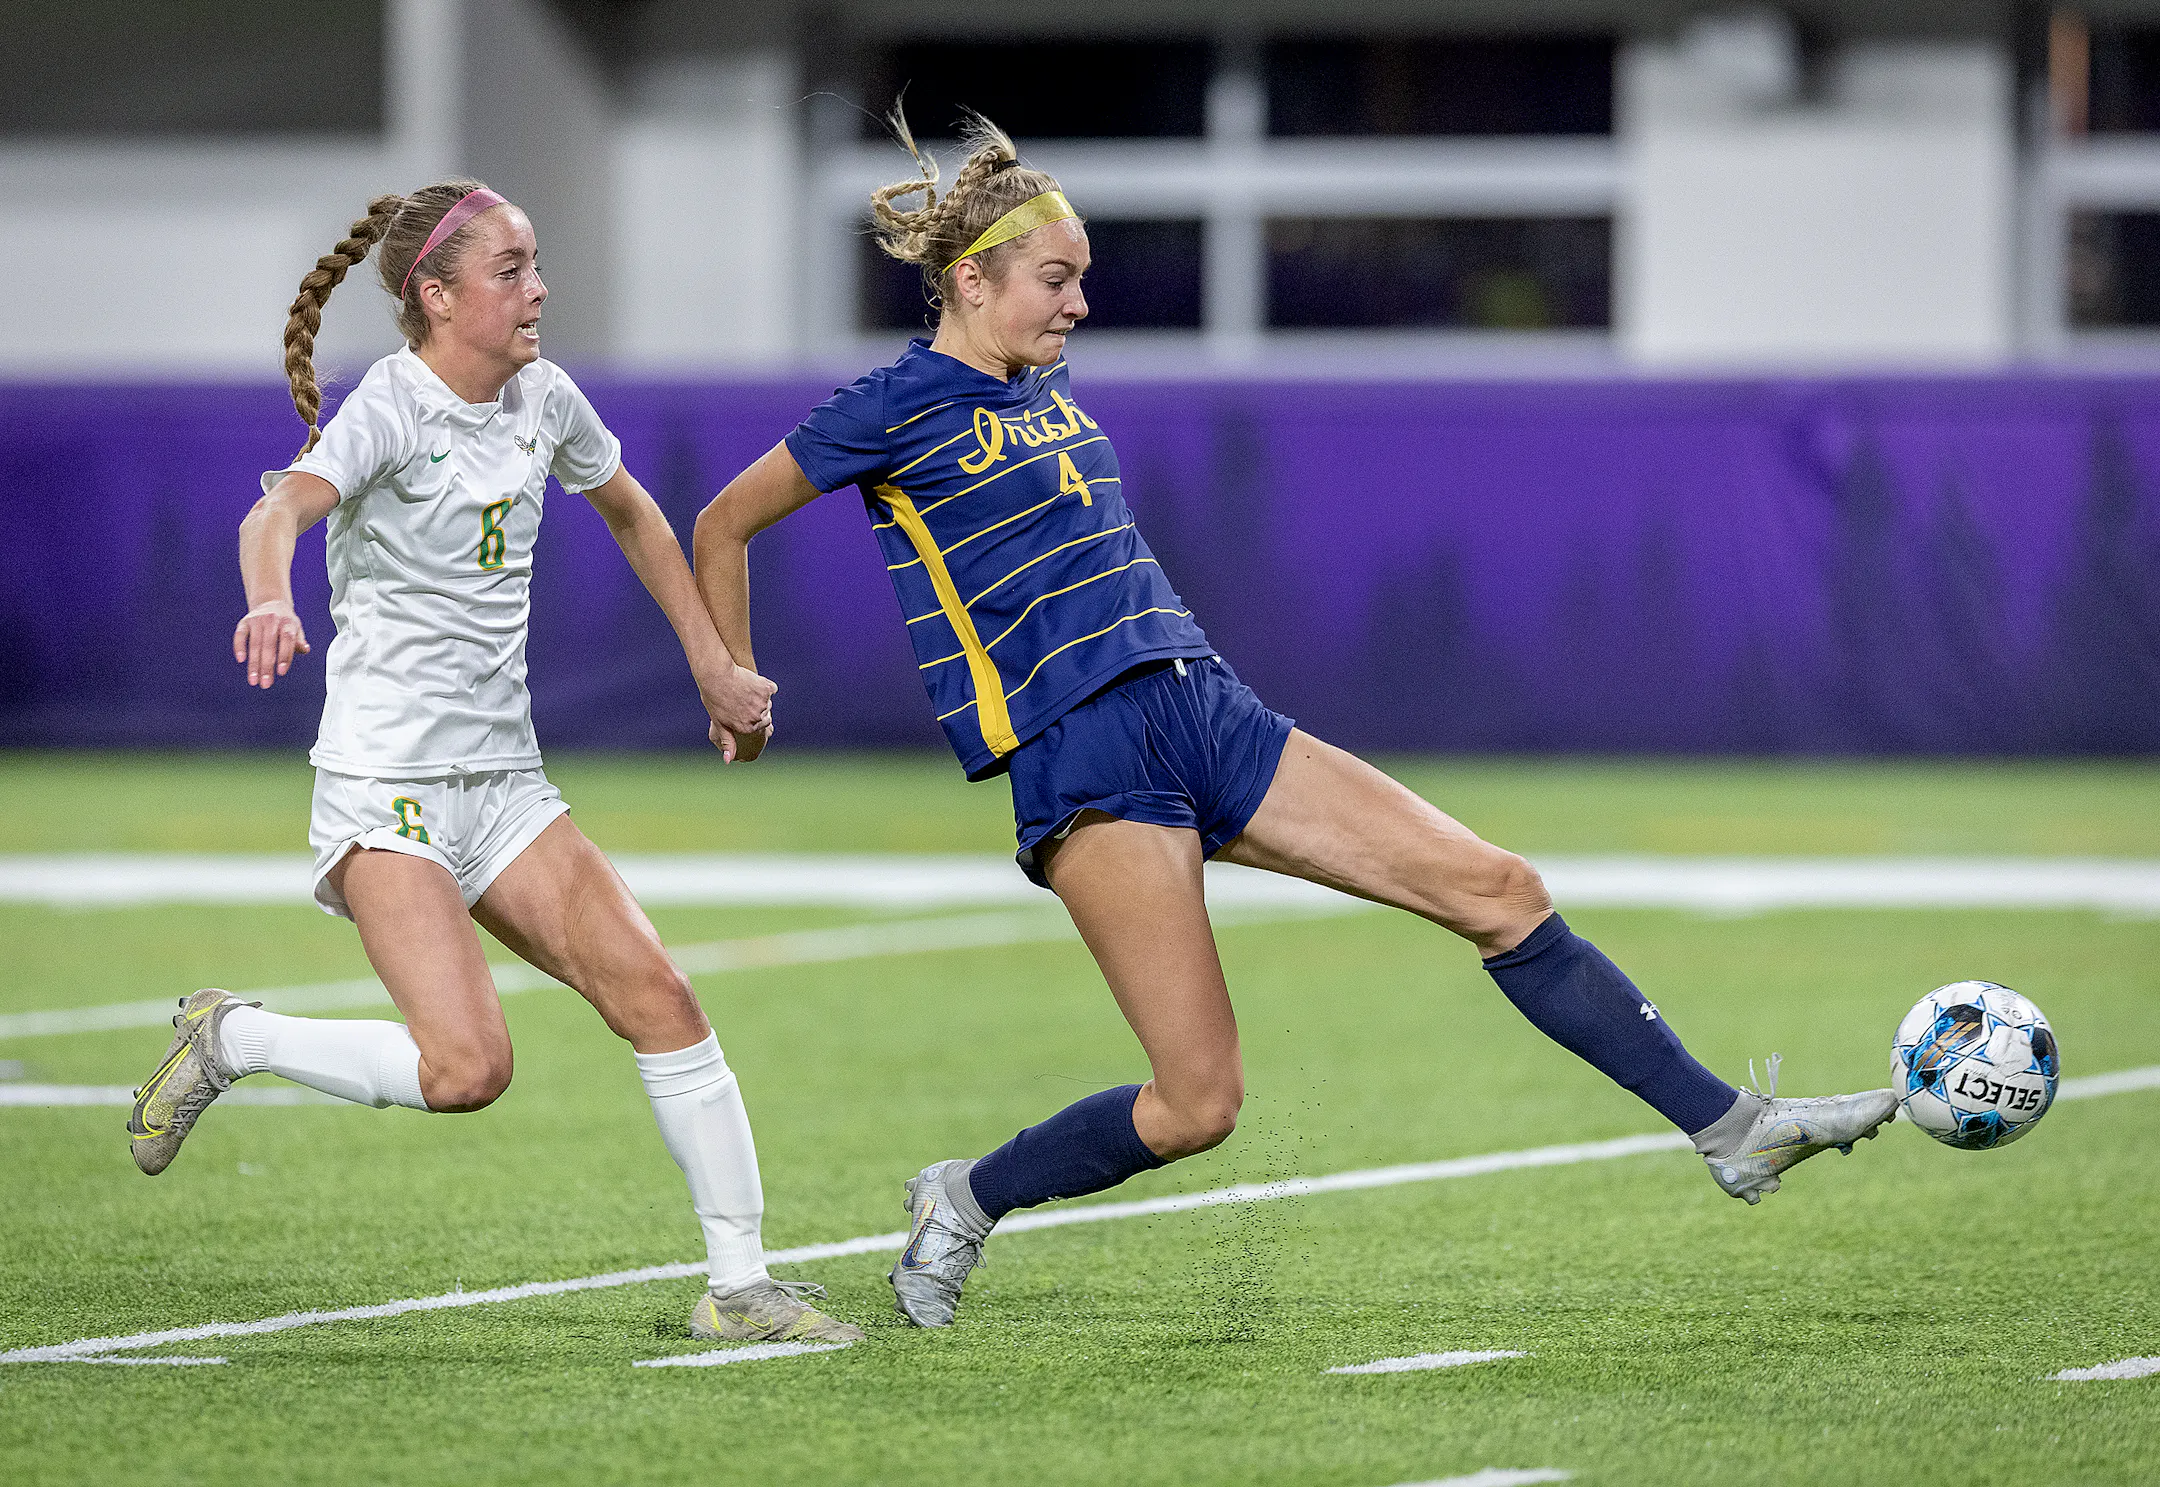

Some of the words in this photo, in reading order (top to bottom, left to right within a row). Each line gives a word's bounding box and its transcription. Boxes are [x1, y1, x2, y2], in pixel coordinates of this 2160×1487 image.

[957, 389, 1098, 475] Irish
[1057, 450, 1093, 507] 4
[391, 795, 431, 845] 6
[1954, 1072, 2042, 1111] SELECT
